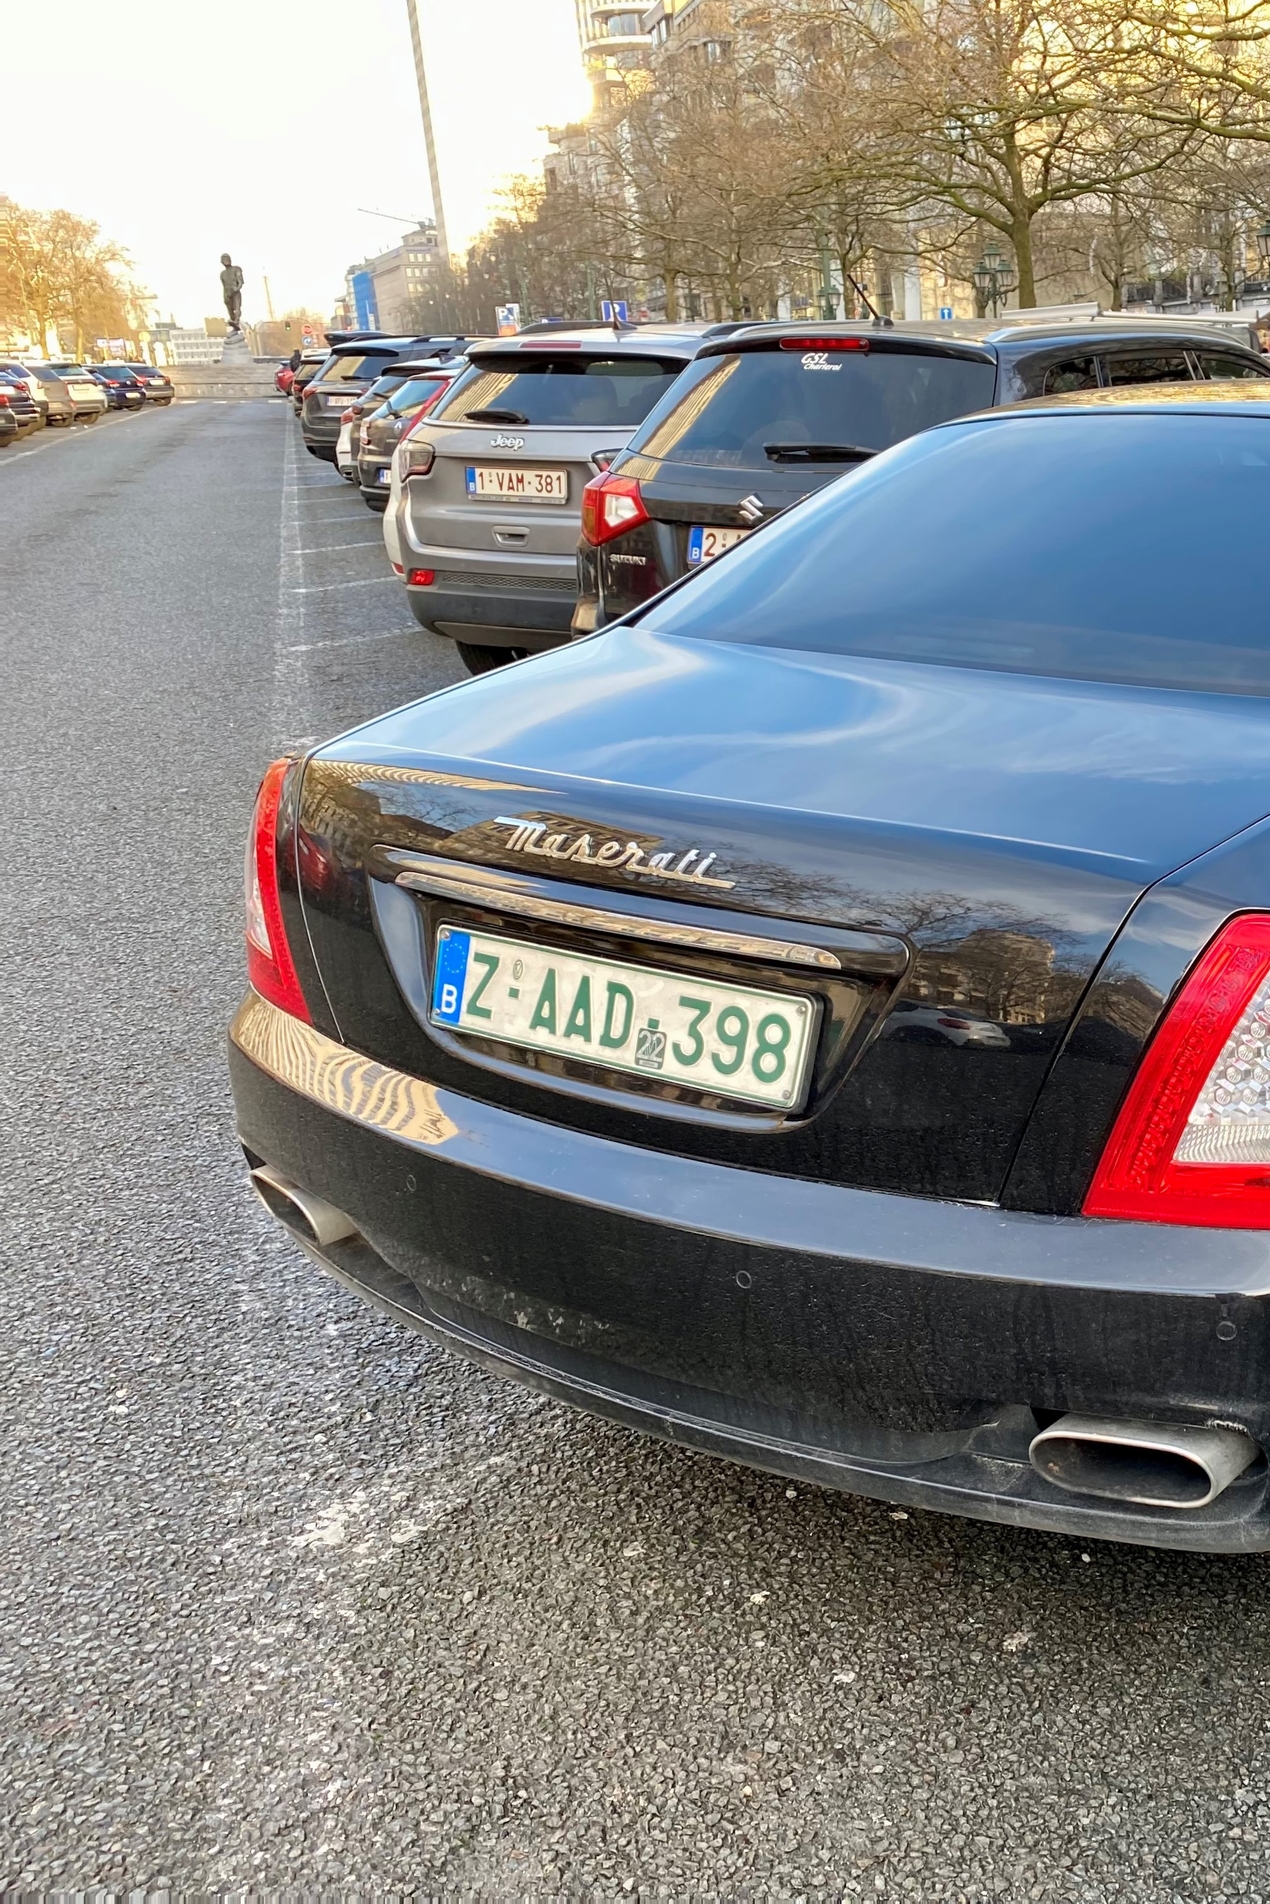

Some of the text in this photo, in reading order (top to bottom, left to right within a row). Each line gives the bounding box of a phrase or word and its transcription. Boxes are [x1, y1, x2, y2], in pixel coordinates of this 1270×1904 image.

[801, 353, 829, 364] GSL
[490, 434, 525, 451] Jeep
[469, 482, 476, 492] B
[691, 547, 700, 560] B
[493, 815, 737, 890] Maserati
[440, 984, 458, 1014] B
